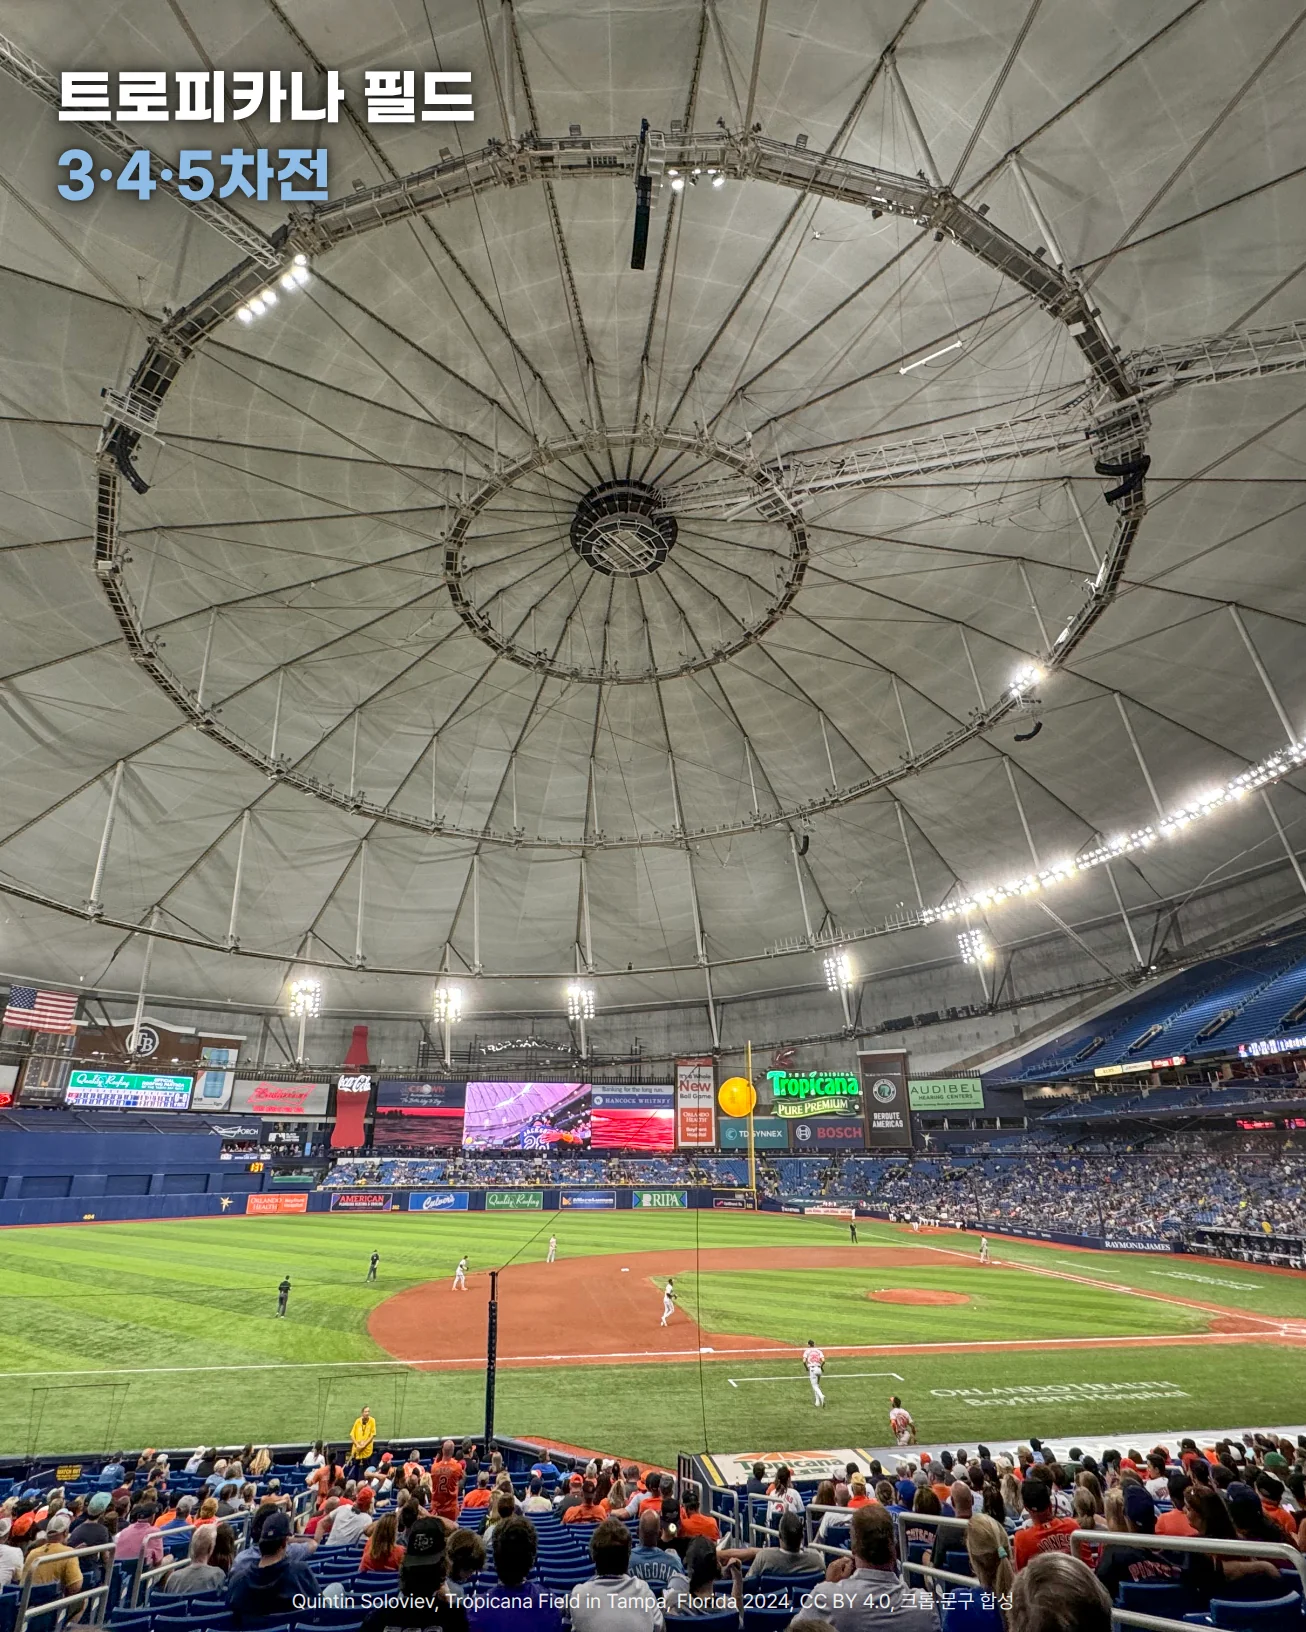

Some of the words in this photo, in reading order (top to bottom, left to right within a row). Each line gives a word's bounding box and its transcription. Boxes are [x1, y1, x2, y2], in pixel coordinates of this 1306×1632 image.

[76, 1074, 102, 1087] Quality
[680, 1080, 711, 1092] New
[766, 1070, 859, 1099] Tropicana
[911, 1084, 981, 1094] AUDIBEL
[779, 1104, 803, 1116] PURE
[804, 1099, 849, 1113] PREMIUM
[872, 1120, 904, 1128] AMERICAS
[739, 1130, 749, 1138] TD
[752, 1129, 783, 1138] SYNNEX
[817, 1127, 862, 1139] BOSCH
[489, 1194, 514, 1207] Quality
[515, 1194, 540, 1207] Roofing
[651, 1194, 680, 1206] RIPA
[1105, 1240, 1146, 1250] RAYMOND
[1144, 1242, 1171, 1251] JAMES
[930, 1383, 1073, 1397] ORLANDO
[1070, 1381, 1181, 1393] HEALTH
[964, 1394, 1086, 1407] Bayfront
[1081, 1390, 1192, 1402] Hospital
[439, 1475, 448, 1492] 2
